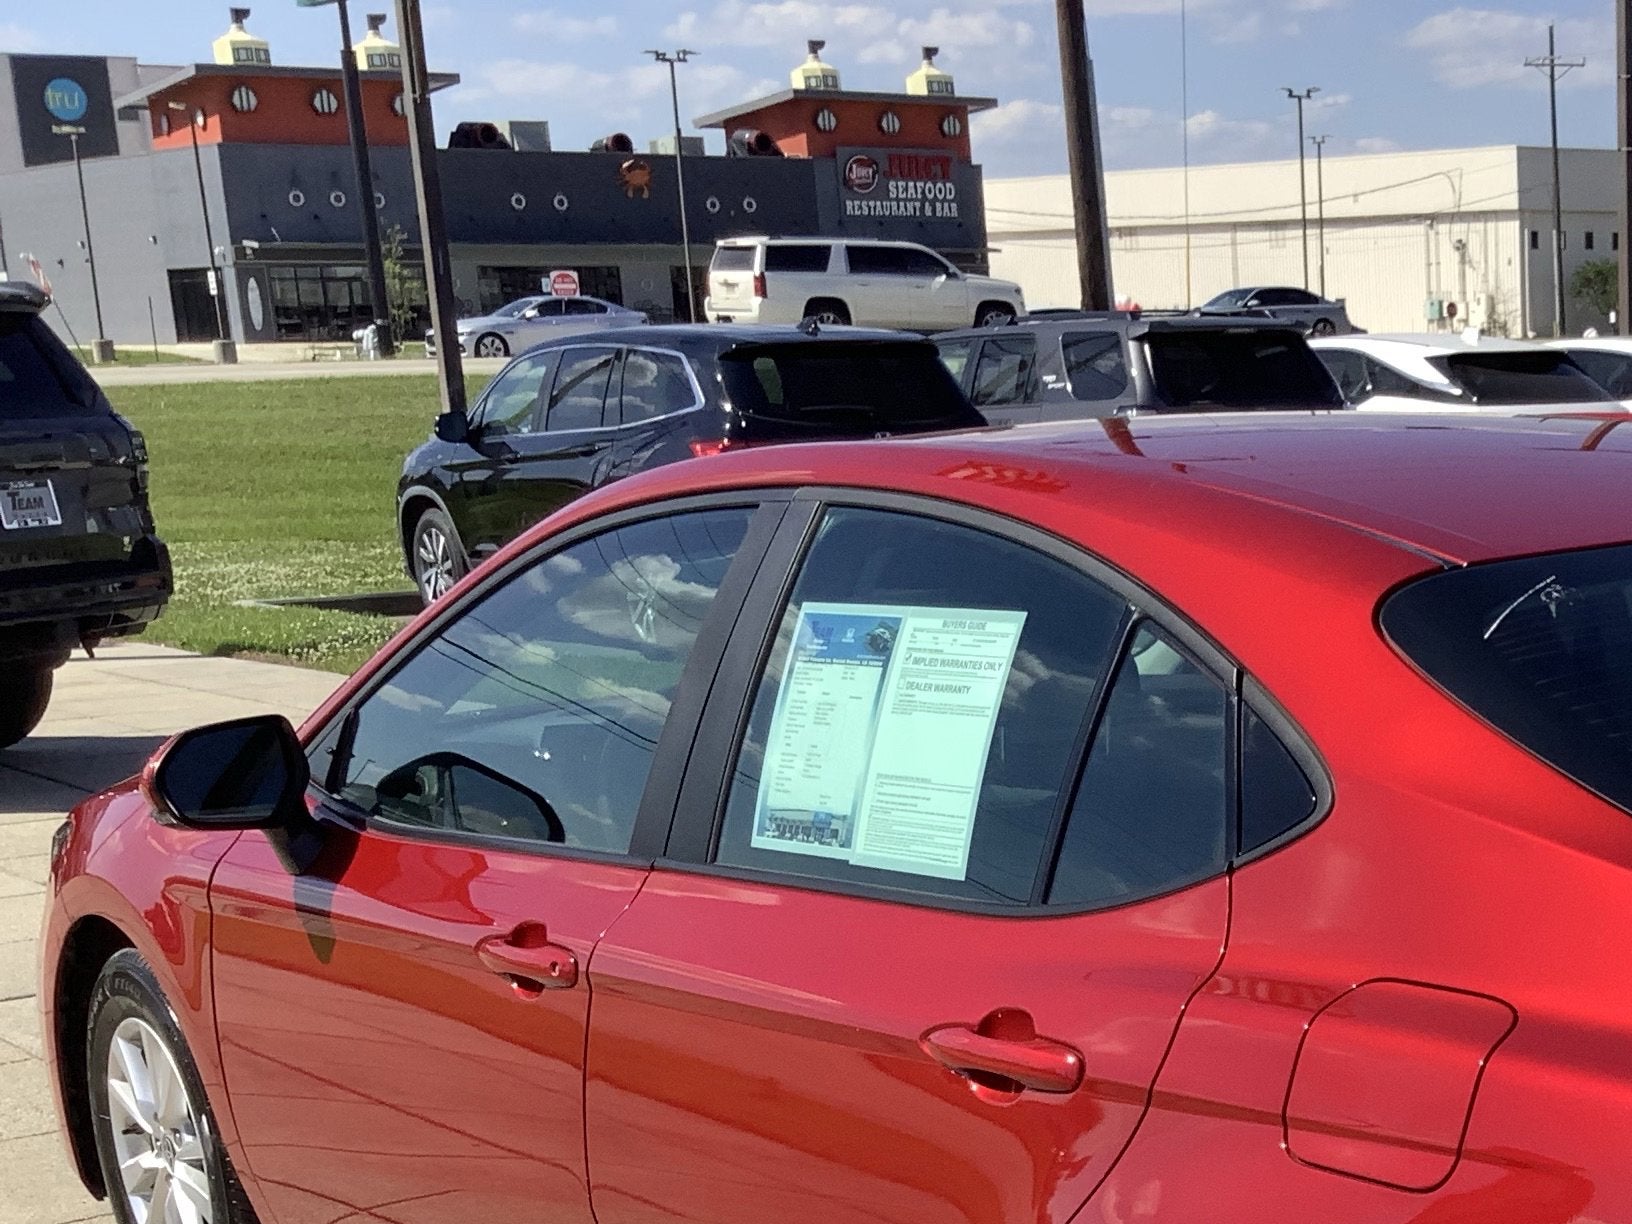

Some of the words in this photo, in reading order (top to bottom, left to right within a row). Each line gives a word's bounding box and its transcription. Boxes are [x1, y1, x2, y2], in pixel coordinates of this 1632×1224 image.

[888, 180, 956, 200] SEAFOOD
[845, 200, 922, 216] RESTAURANT
[924, 201, 933, 217] &
[935, 202, 959, 217] BAR
[6, 491, 45, 511] TEAM
[967, 621, 987, 630] GUIDE
[912, 656, 939, 667] IMPLIED
[939, 658, 983, 670] WARRANTIES
[983, 661, 1003, 671] ONLY
[906, 681, 933, 692] DEALER
[933, 683, 972, 694] WARRANTY
